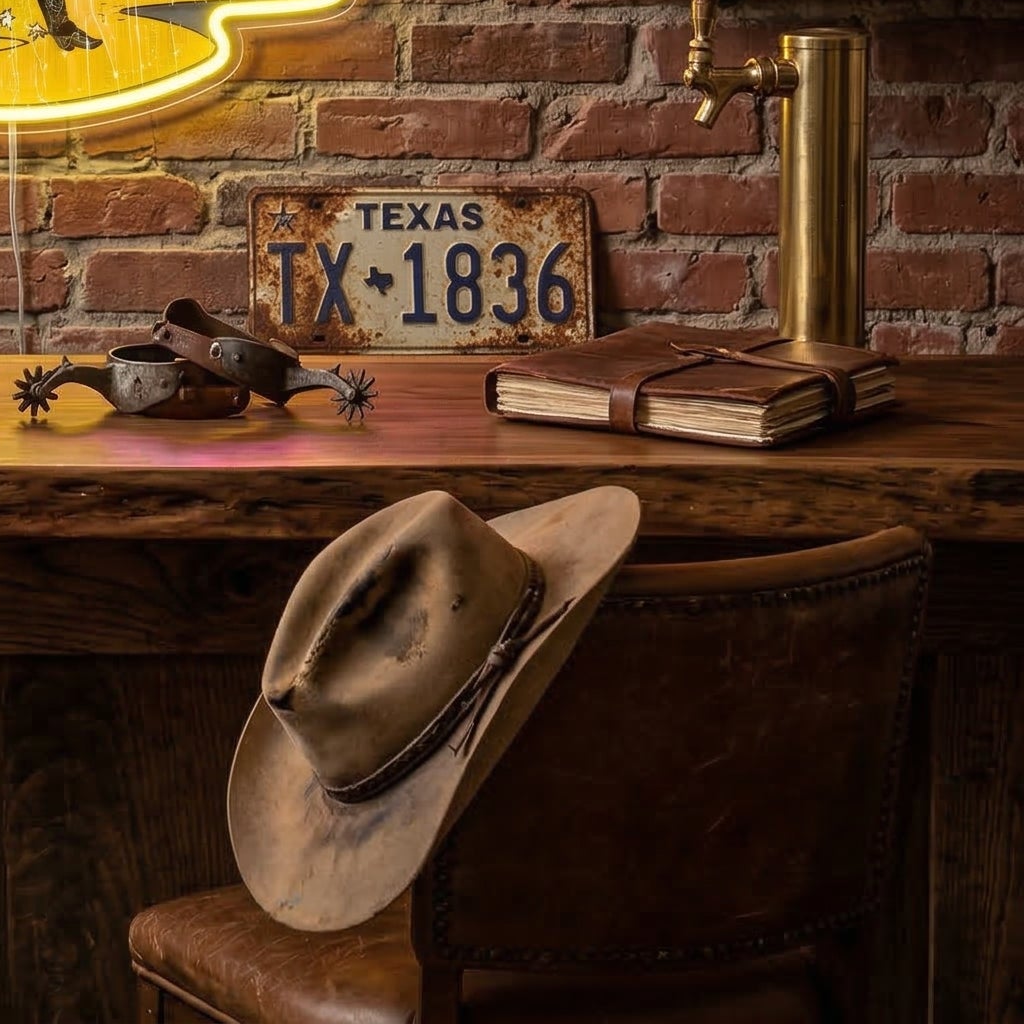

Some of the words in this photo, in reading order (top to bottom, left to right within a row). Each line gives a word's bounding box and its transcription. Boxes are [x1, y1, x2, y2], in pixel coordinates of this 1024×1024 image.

[355, 202, 484, 231] TEXAS
[266, 241, 354, 325] TX
[401, 241, 576, 325] 1836
